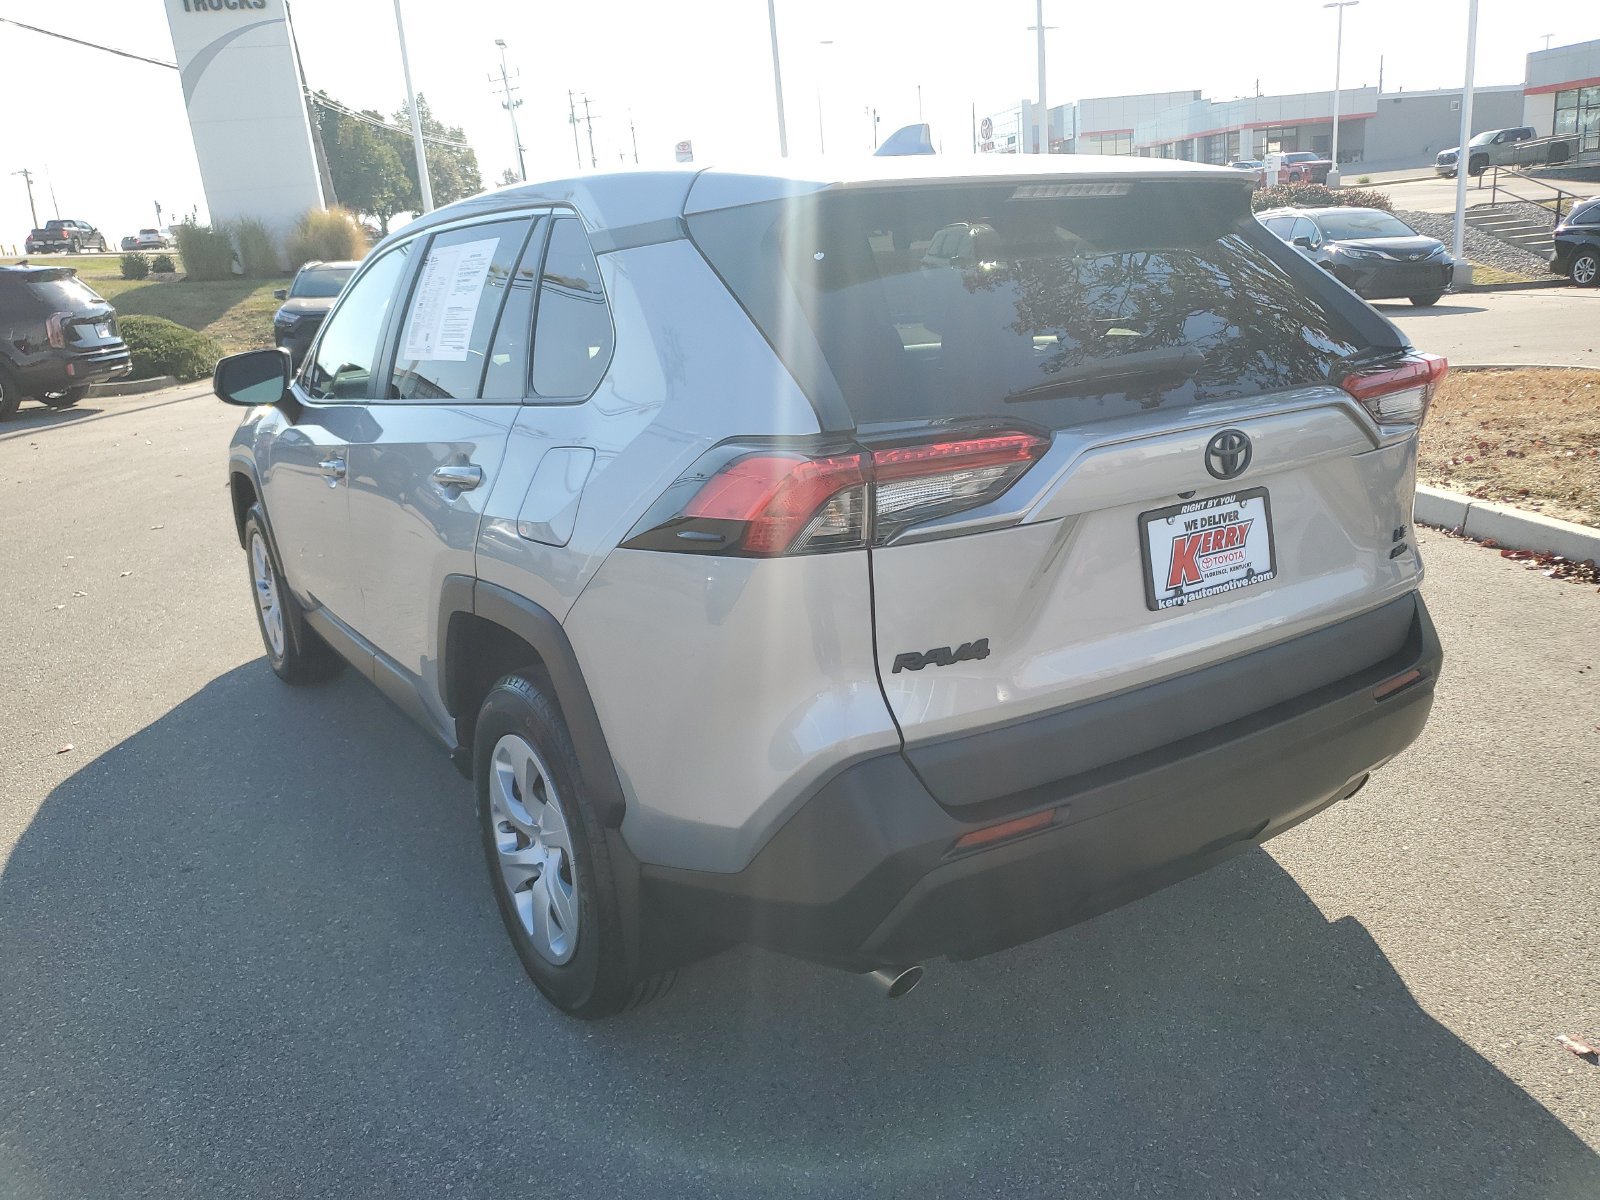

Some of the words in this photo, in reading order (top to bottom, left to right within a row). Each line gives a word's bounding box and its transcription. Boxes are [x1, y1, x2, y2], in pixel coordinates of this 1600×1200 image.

[1181, 502, 1206, 514] RIGHT
[1206, 498, 1219, 508] BY
[1220, 495, 1237, 505] YOU
[1184, 520, 1198, 532] WE
[1200, 510, 1239, 527] DELIVER
[1166, 519, 1254, 590] KERRY
[1213, 551, 1244, 566] TOYOTA
[1158, 571, 1273, 609] kerryautomotive.com
[892, 638, 990, 674] RAV4
